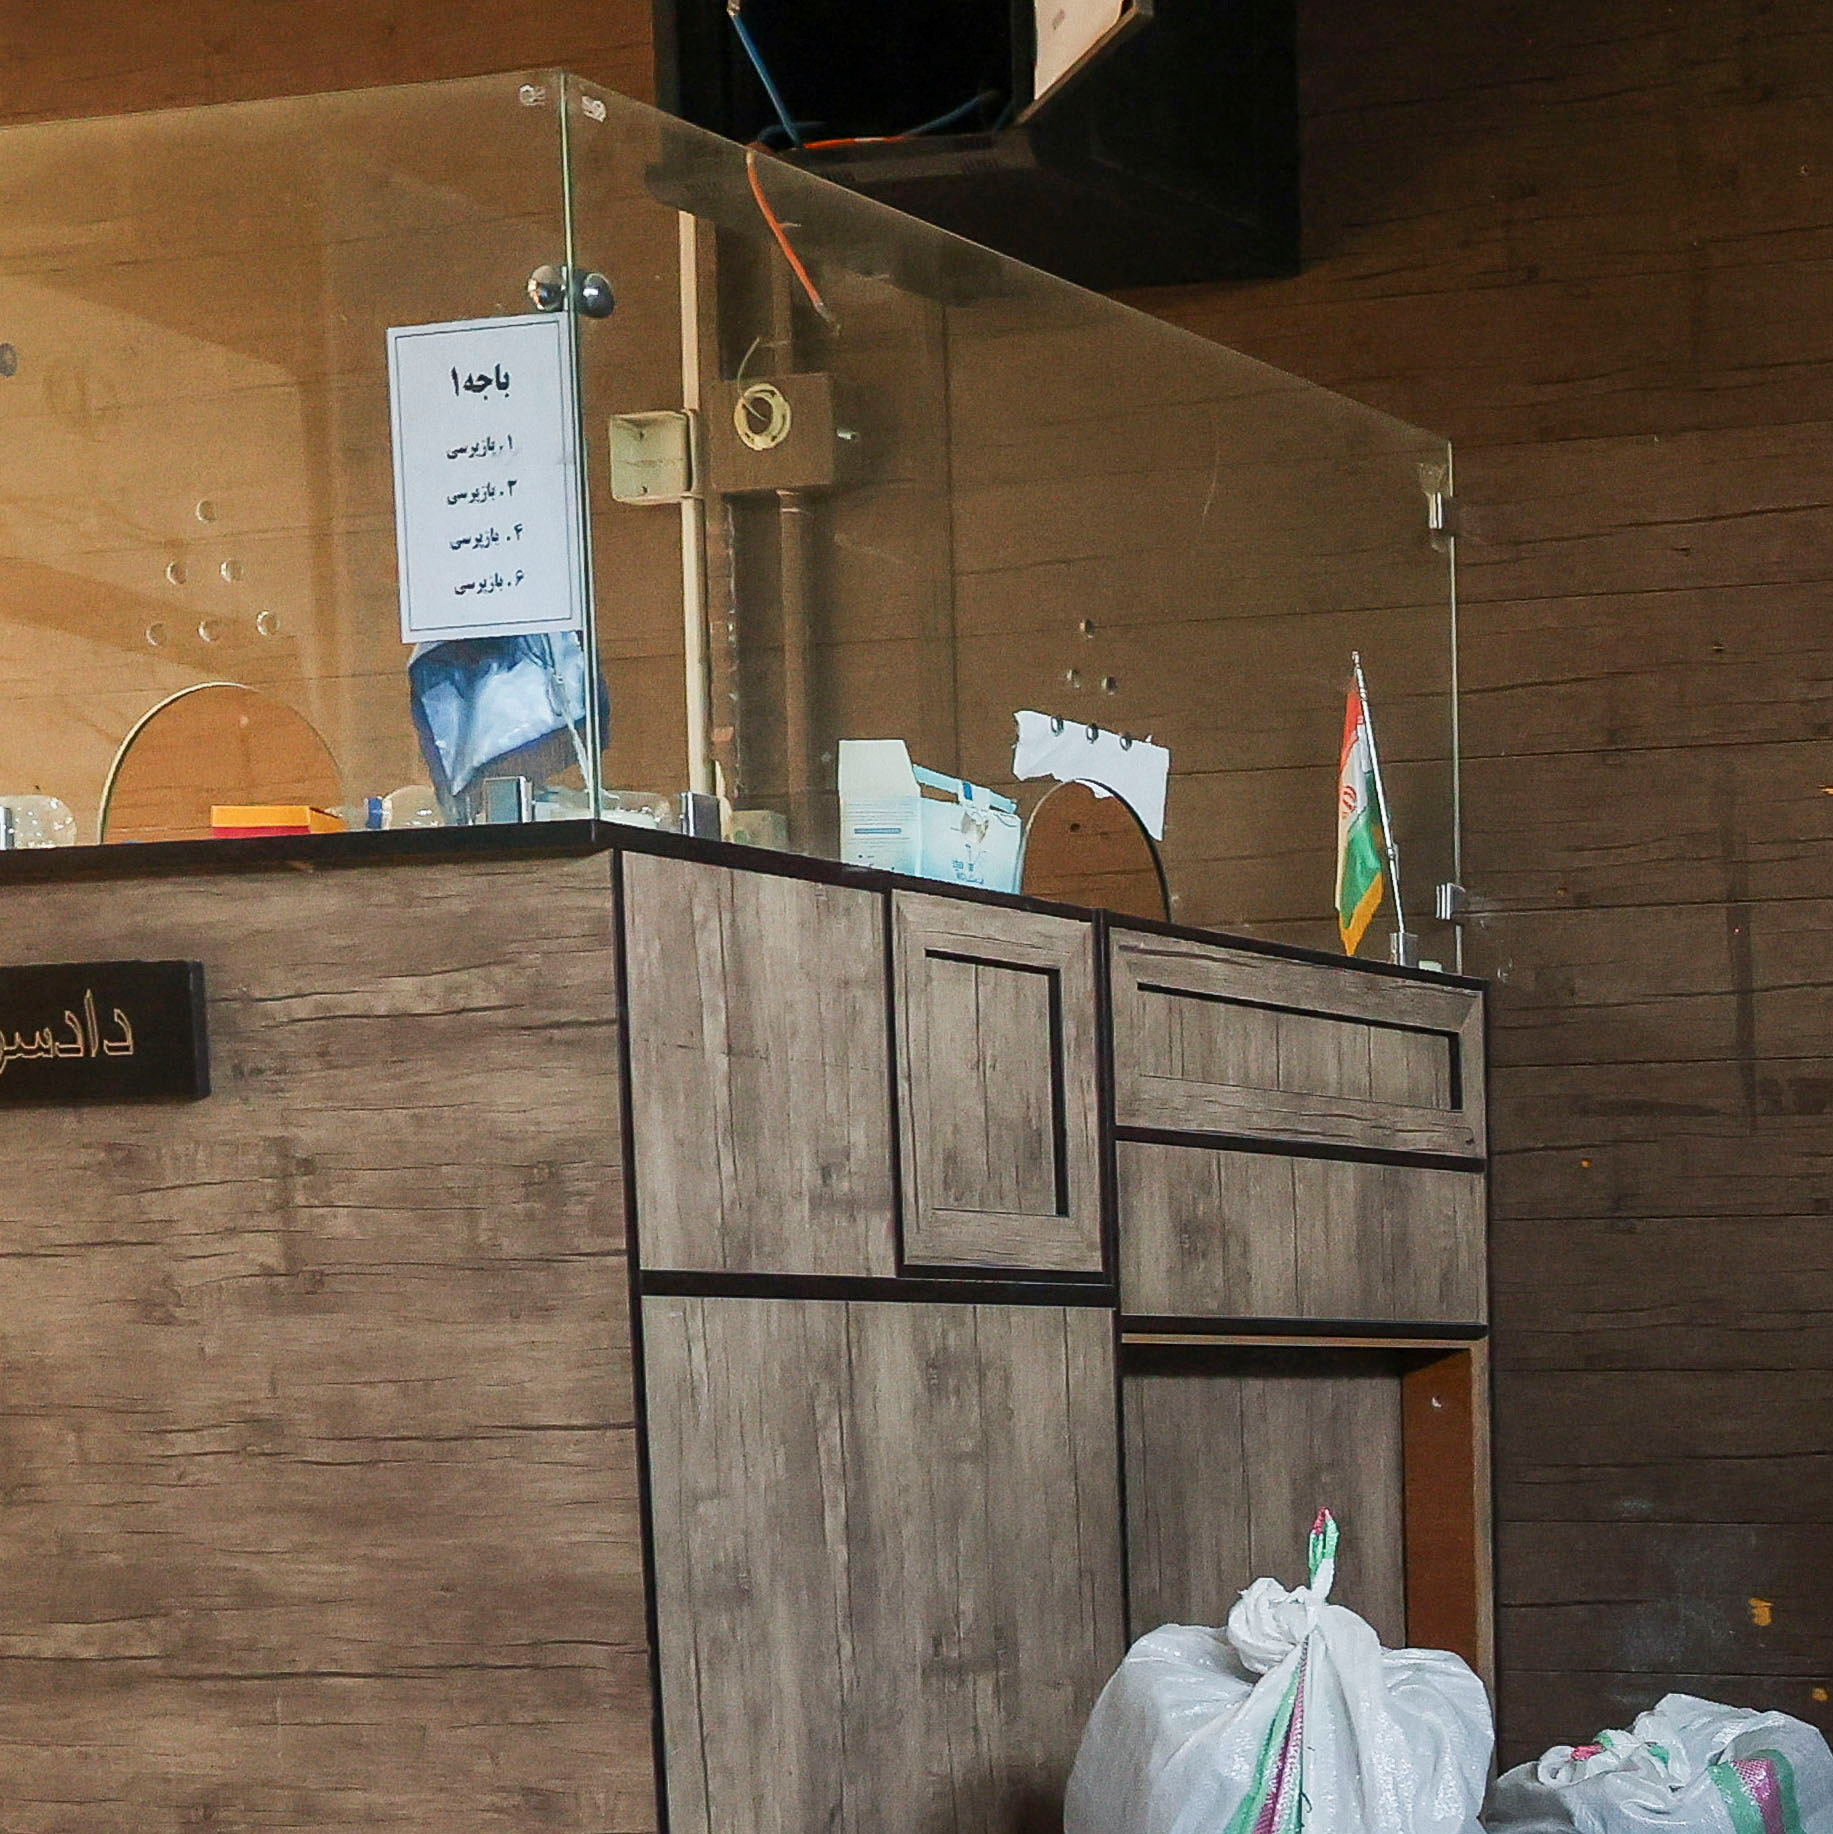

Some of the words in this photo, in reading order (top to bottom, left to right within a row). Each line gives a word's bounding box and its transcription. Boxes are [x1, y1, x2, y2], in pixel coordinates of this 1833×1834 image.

[446, 483, 496, 505] بازپرسی
[450, 528, 500, 550] بازپرسی
[454, 572, 504, 595] بازپرسی
